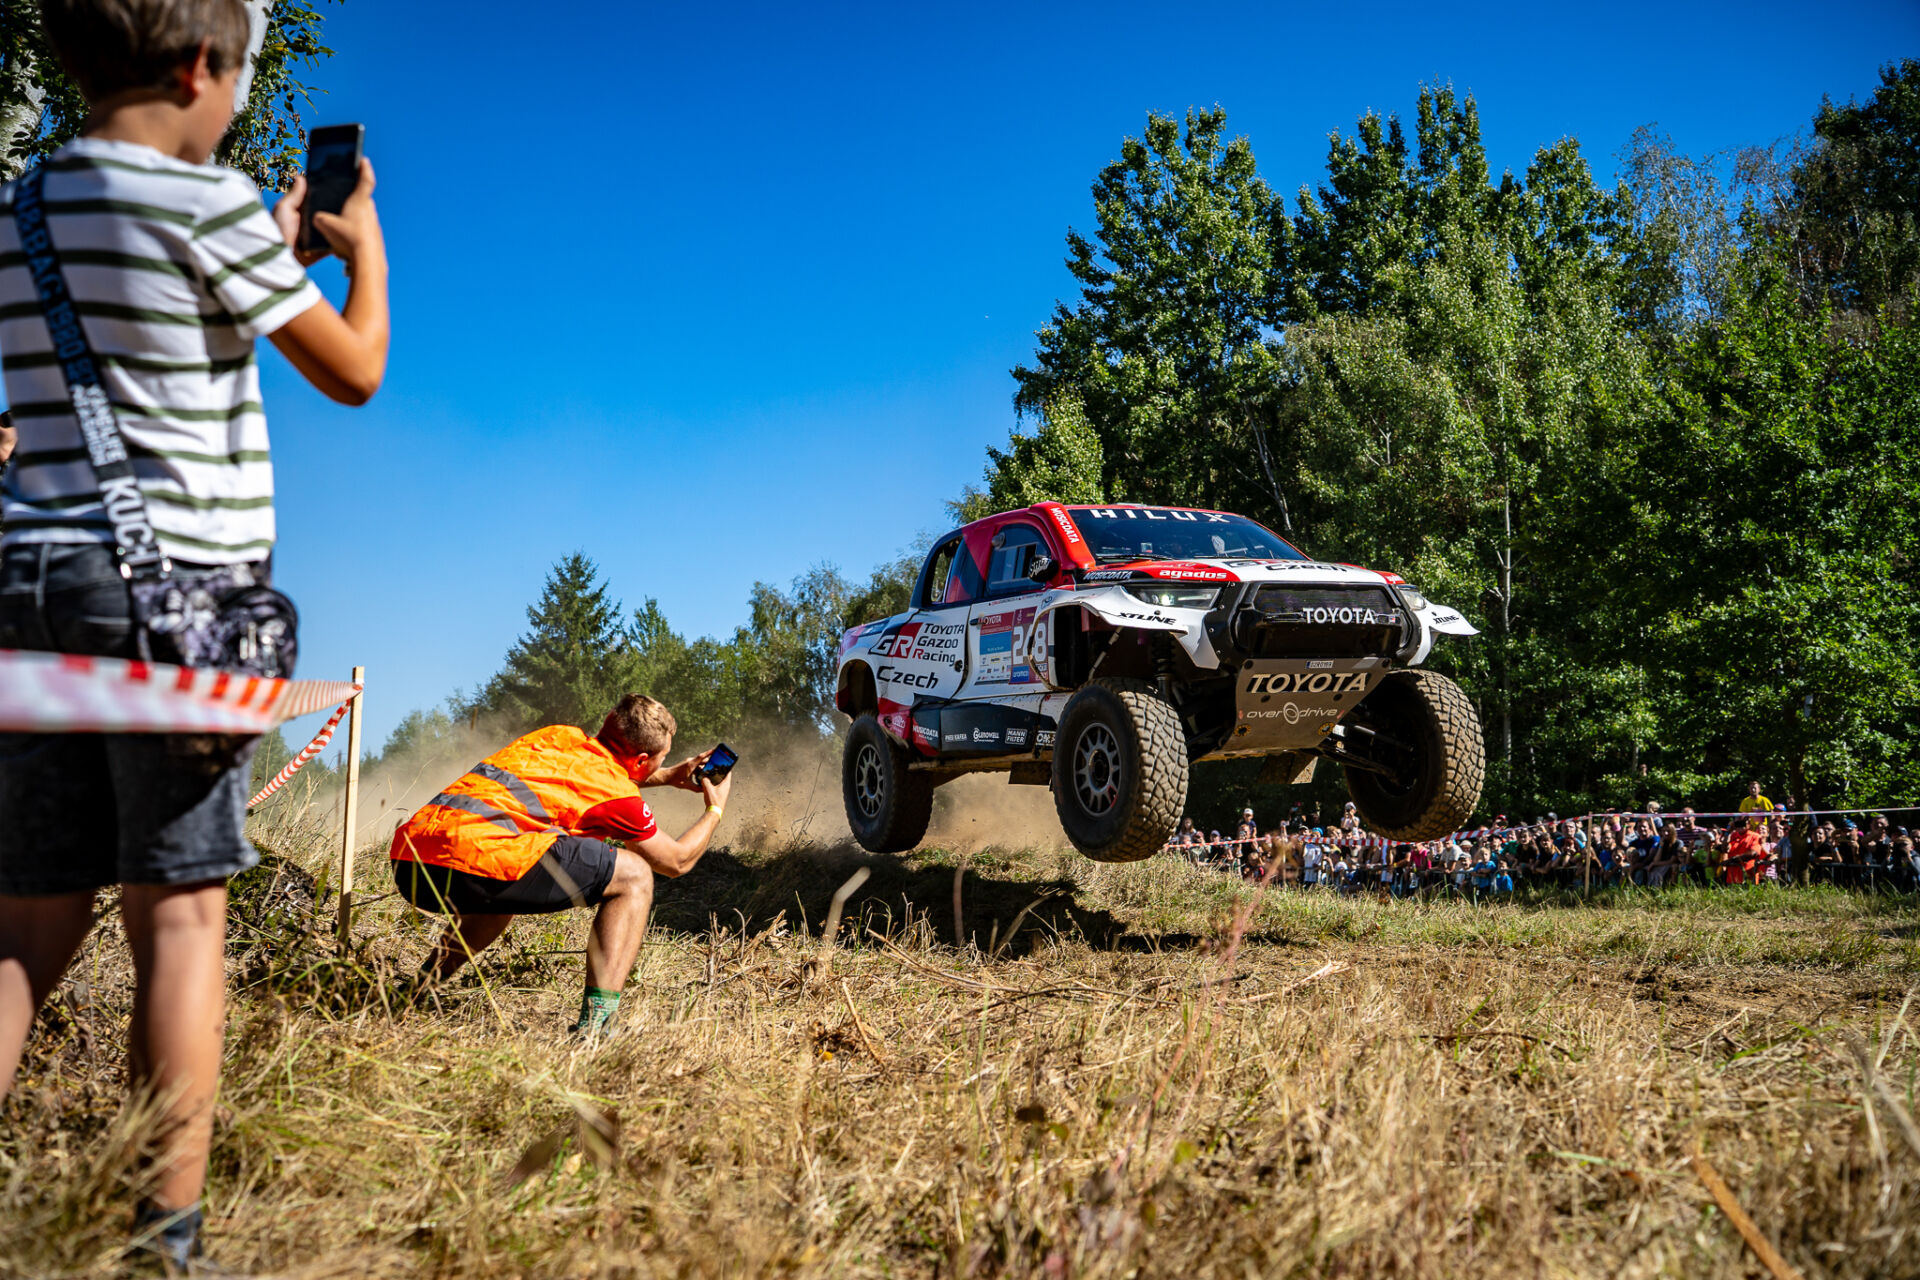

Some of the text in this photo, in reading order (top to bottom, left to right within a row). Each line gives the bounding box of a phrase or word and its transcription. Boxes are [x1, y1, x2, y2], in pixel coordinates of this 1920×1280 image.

[1089, 509, 1231, 523] HILUX
[1050, 507, 1080, 544] MUSICDATA
[1083, 570, 1133, 581] MUSICDATA
[1159, 569, 1227, 579] agados
[1120, 612, 1177, 626] XTLINE
[1303, 607, 1376, 625] TOYOTA
[923, 622, 965, 635] TOYOTA
[869, 633, 914, 659] GR
[917, 636, 958, 649] GAZOO
[912, 648, 956, 667] Racing
[877, 665, 939, 689] Czech
[1250, 672, 1368, 694] TOYOTA
